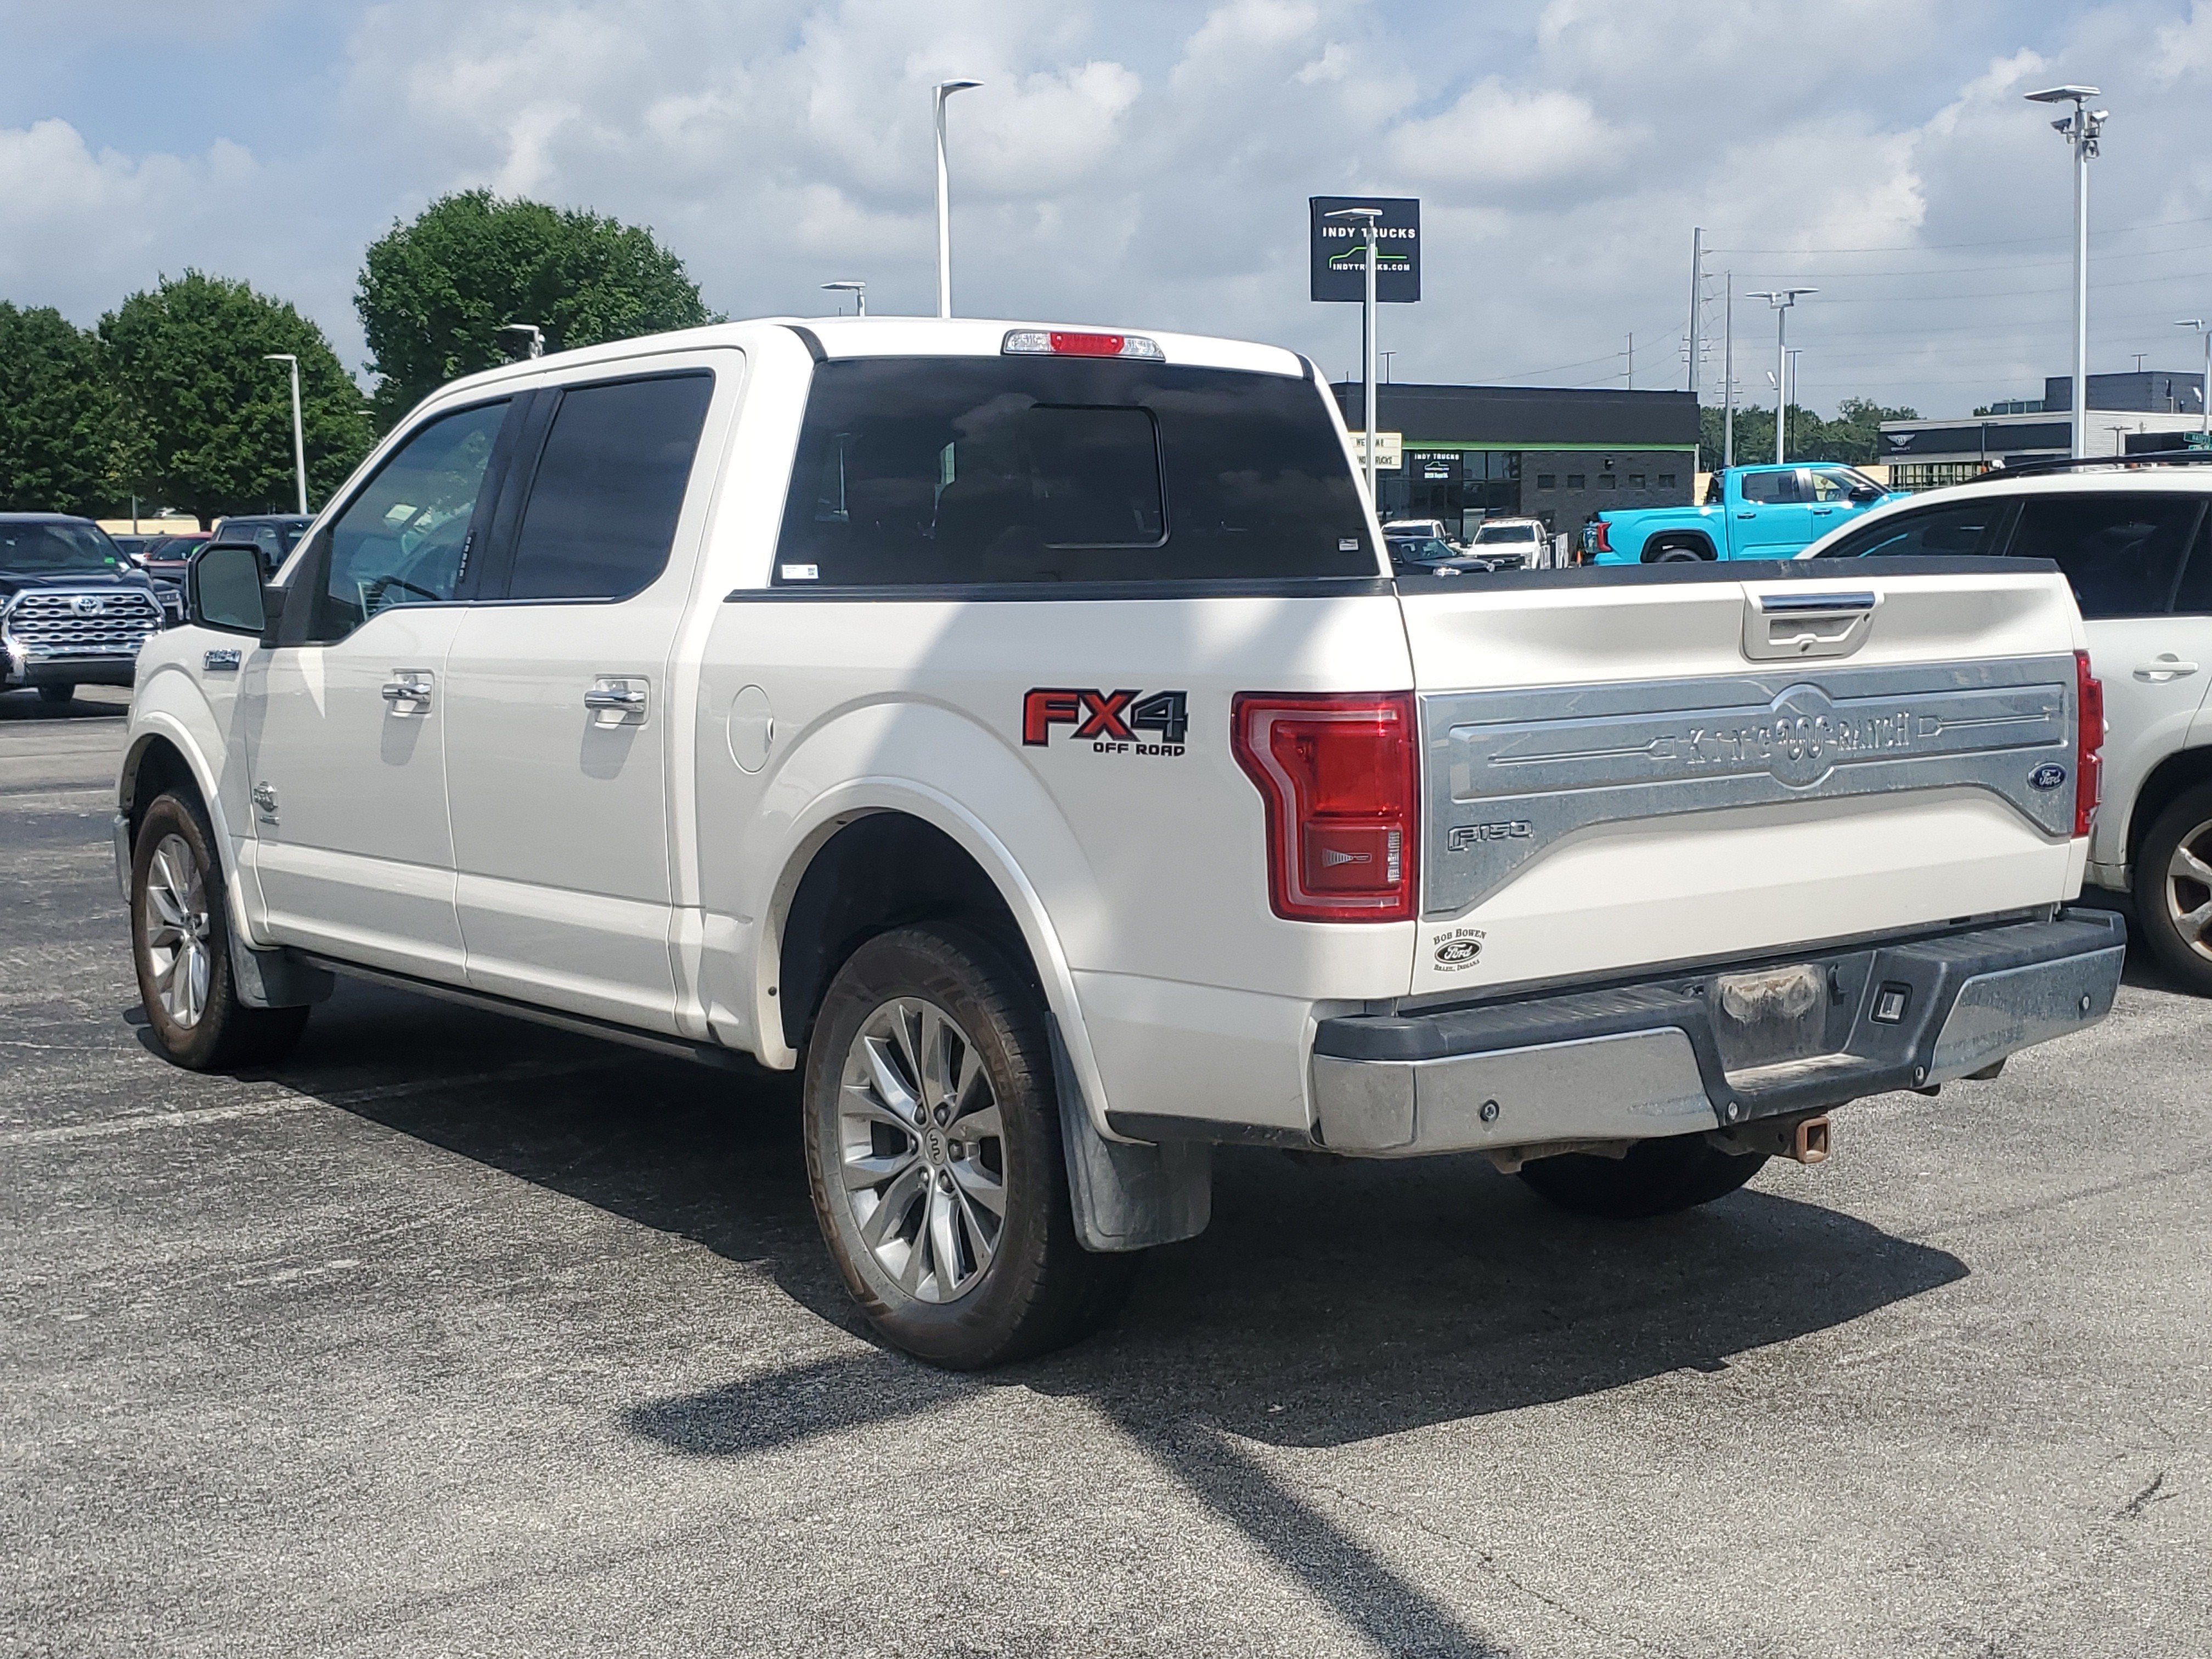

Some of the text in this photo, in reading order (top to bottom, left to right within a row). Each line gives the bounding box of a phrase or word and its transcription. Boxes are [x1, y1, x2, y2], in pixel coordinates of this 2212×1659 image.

[1322, 227, 1415, 239] INDY TRUCKS
[1023, 687, 1188, 747] FX4
[1093, 742, 1186, 757] OFF ROAD
[2038, 769, 2062, 786] Ford
[1433, 929, 1487, 945] BOB BOWEN
[1443, 943, 1473, 960] Ford
